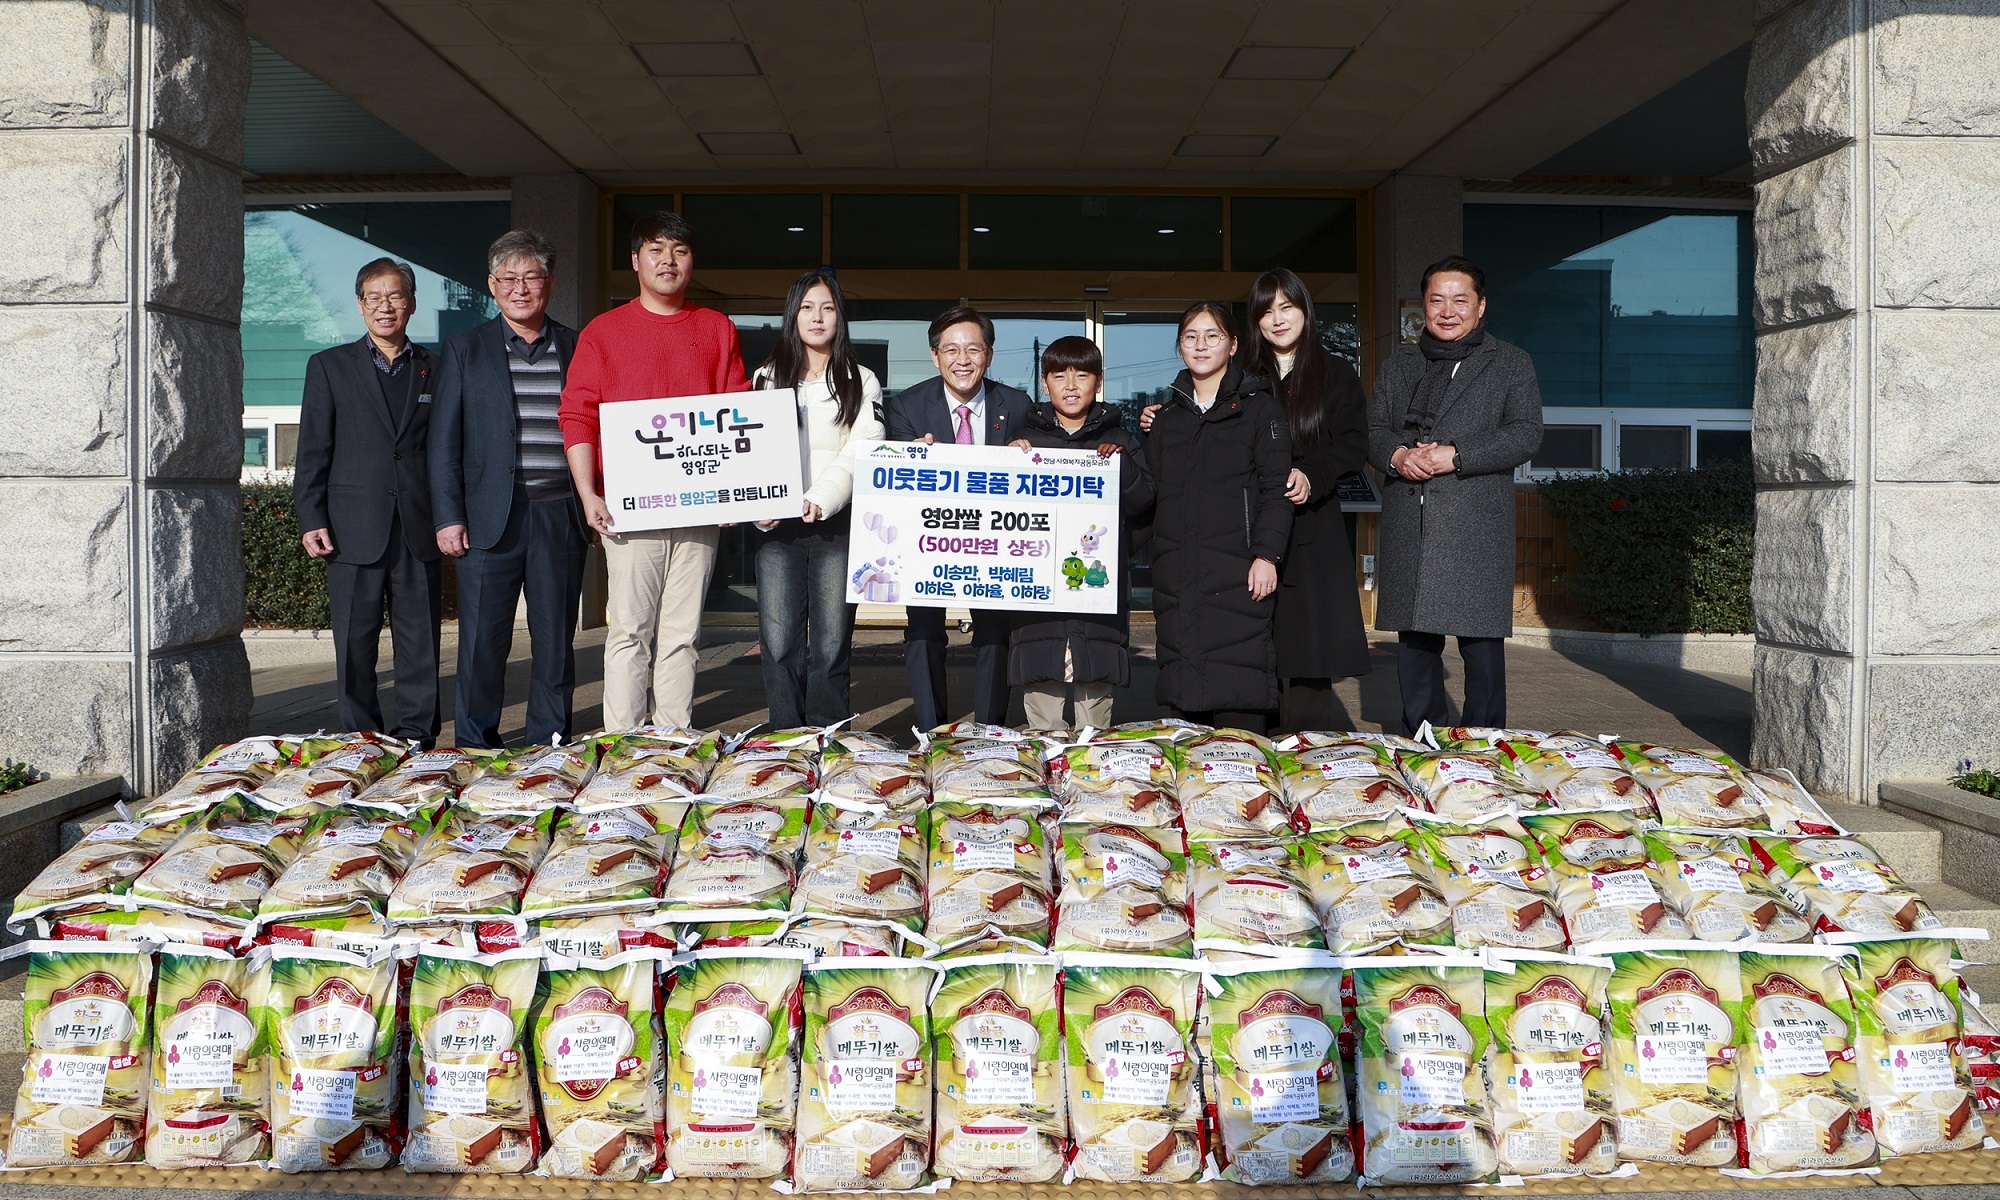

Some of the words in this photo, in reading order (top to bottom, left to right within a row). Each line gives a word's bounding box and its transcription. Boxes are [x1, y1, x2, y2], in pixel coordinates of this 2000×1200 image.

[635, 408, 763, 460] 온기나눔
[676, 444, 732, 459] 하나되는
[907, 446, 928, 459] 영암
[682, 460, 720, 475] 영암군
[1056, 459, 1109, 467] 사회복지공동모금회
[873, 467, 959, 492] 이웃돕기
[967, 472, 1009, 494] 물품
[1016, 474, 1104, 498] 지정기탁
[623, 497, 635, 510] 더
[639, 494, 676, 509] 따뜻한
[680, 490, 730, 506] 영암군을
[734, 485, 787, 501] 만듭니다!
[921, 508, 982, 530] 영암쌀
[991, 511, 1050, 531] 200포
[919, 535, 998, 555] (500만원
[1008, 540, 1050, 558] 상당)
[933, 564, 980, 582] 이송만,
[989, 567, 1033, 583] 박혜림
[915, 581, 956, 597] 이하은,
[963, 584, 1004, 600] 이하율,
[1011, 586, 1051, 600] 이하랑
[1203, 751, 1253, 759] 메뚜기쌀
[1215, 762, 1253, 773] 사랑의열매
[1105, 810, 1146, 823] (유)라이스상사
[856, 830, 899, 840] 사랑의열매
[901, 825, 917, 834] 햅쌀
[179, 880, 226, 896] (유)라이스상사
[303, 882, 348, 892] (유)라이스상사
[564, 878, 611, 888] (유)라이스상사
[697, 884, 745, 893] (유)라이스상사
[431, 890, 477, 898] (유)라이스상사
[835, 892, 884, 905] (유)라이스상사
[962, 914, 1010, 922] (유)라이스상사
[1101, 928, 1149, 937] (유)라이스상사
[1491, 931, 1535, 943] (유)라이스상사
[545, 938, 603, 957] 메뚜기쌀
[73, 1009, 102, 1024] 황금
[1664, 1006, 1692, 1020] 황금
[1780, 1005, 1806, 1018] 황금
[1897, 1006, 1948, 1024] 메뚜기쌀
[456, 1020, 480, 1035] 황금
[1416, 1017, 1440, 1032] 황금
[1542, 1014, 1568, 1029] 황금
[55, 1024, 113, 1041] 메뚜기쌀
[853, 1024, 880, 1039] 황금
[979, 1025, 1005, 1038] 황금
[1120, 1024, 1146, 1040] 황금
[1266, 1028, 1294, 1043] 황금
[1530, 1028, 1585, 1046] 메뚜기쌀
[1650, 1021, 1711, 1039] 메뚜기쌀
[301, 1032, 359, 1050] 메뚜기쌀
[441, 1034, 496, 1051] 메뚜기쌀
[573, 1036, 616, 1052] 사랑의열매
[699, 1034, 756, 1051] 메뚜기쌀
[966, 1037, 1022, 1053] 메뚜기쌀
[1403, 1031, 1456, 1049] 메뚜기쌀
[1778, 1031, 1821, 1045] 사랑의열매
[183, 1045, 231, 1060] 사랑의열매
[837, 1040, 899, 1057] 메뚜기쌀
[1105, 1040, 1165, 1055] 메뚜기쌀
[1253, 1041, 1315, 1060] 메뚜기쌀
[1658, 1041, 1705, 1055] 사랑의열매
[56, 1061, 107, 1077] 사랑의열매
[111, 1056, 132, 1069] 햅쌀
[620, 1058, 638, 1071] 햅쌀
[906, 1060, 922, 1070] 햅쌀
[982, 1061, 1028, 1076] 사랑의열매
[1122, 1061, 1168, 1078] 사랑의열매
[1321, 1061, 1333, 1076] 햅쌀
[1417, 1059, 1463, 1076] 사랑의열매
[364, 1067, 381, 1081] 햅쌀
[441, 1071, 486, 1086] 사랑의열매
[709, 1072, 758, 1088] 사랑의열매
[844, 1067, 893, 1082] 사랑의열매
[1535, 1068, 1581, 1084] 사랑의열매
[306, 1075, 354, 1092] 사랑의열매
[1266, 1076, 1314, 1093] 사랑의열매
[632, 1146, 643, 1155] kg
[900, 1153, 908, 1161] 10
[909, 1152, 918, 1162] kg
